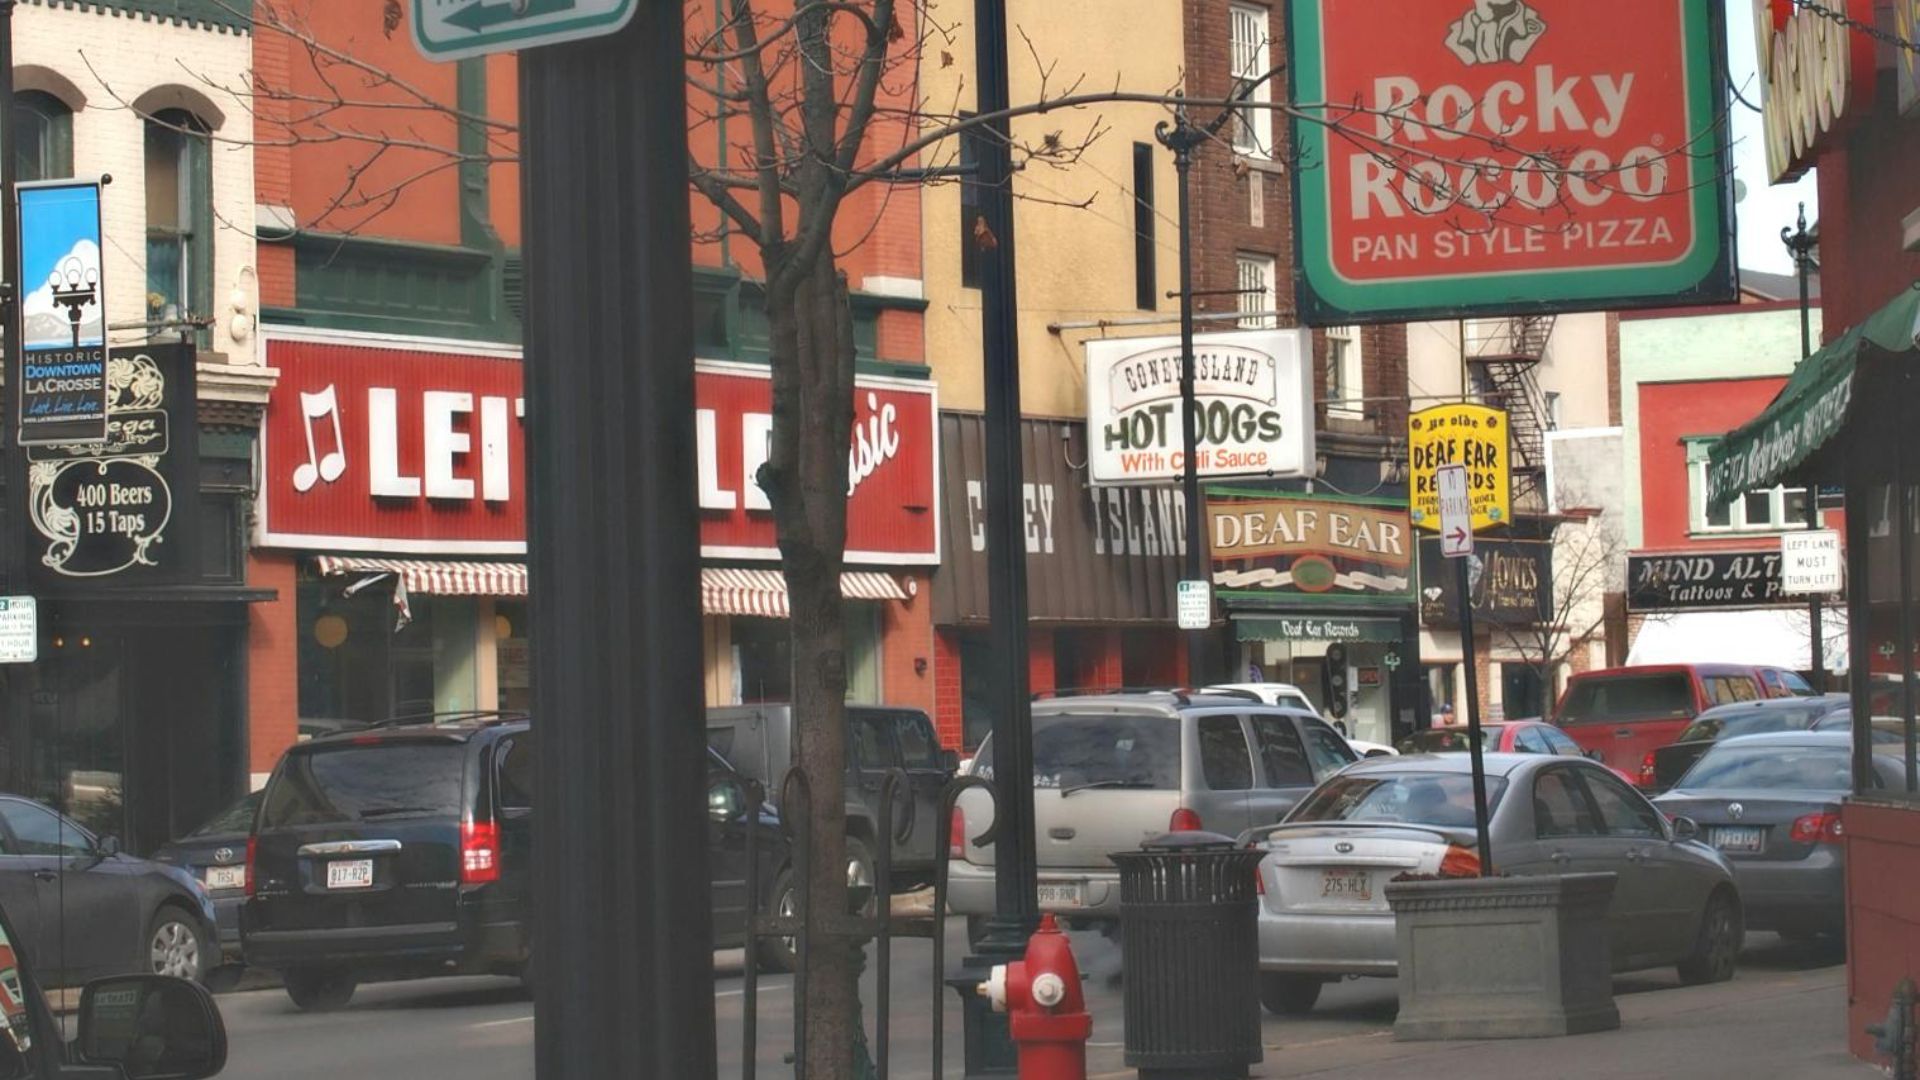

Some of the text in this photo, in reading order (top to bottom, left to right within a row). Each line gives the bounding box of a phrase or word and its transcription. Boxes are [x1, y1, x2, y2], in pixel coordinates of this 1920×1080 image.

[1352, 216, 1673, 262] PAN STYLE PIZZA
[25, 351, 101, 364] HISTORIC
[25, 363, 102, 378] DOWNTOWN
[1125, 356, 1183, 392] CONEY
[1104, 403, 1174, 451] HOT
[1121, 448, 1269, 473] With Cili Sauce
[1414, 438, 1498, 470] DEAF EAR
[76, 483, 153, 507] 400 Beers
[87, 510, 146, 538] 15 Taps
[966, 480, 1055, 554] CEY
[1215, 510, 1403, 556] DEAF EAR
[1787, 539, 1835, 550] LEFT LANE
[1639, 557, 1715, 582] MIND
[1797, 556, 1827, 568] MUST
[1668, 582, 1733, 602] Tattoos
[1740, 582, 1755, 599] &
[1788, 574, 1836, 585] TURN LEFT
